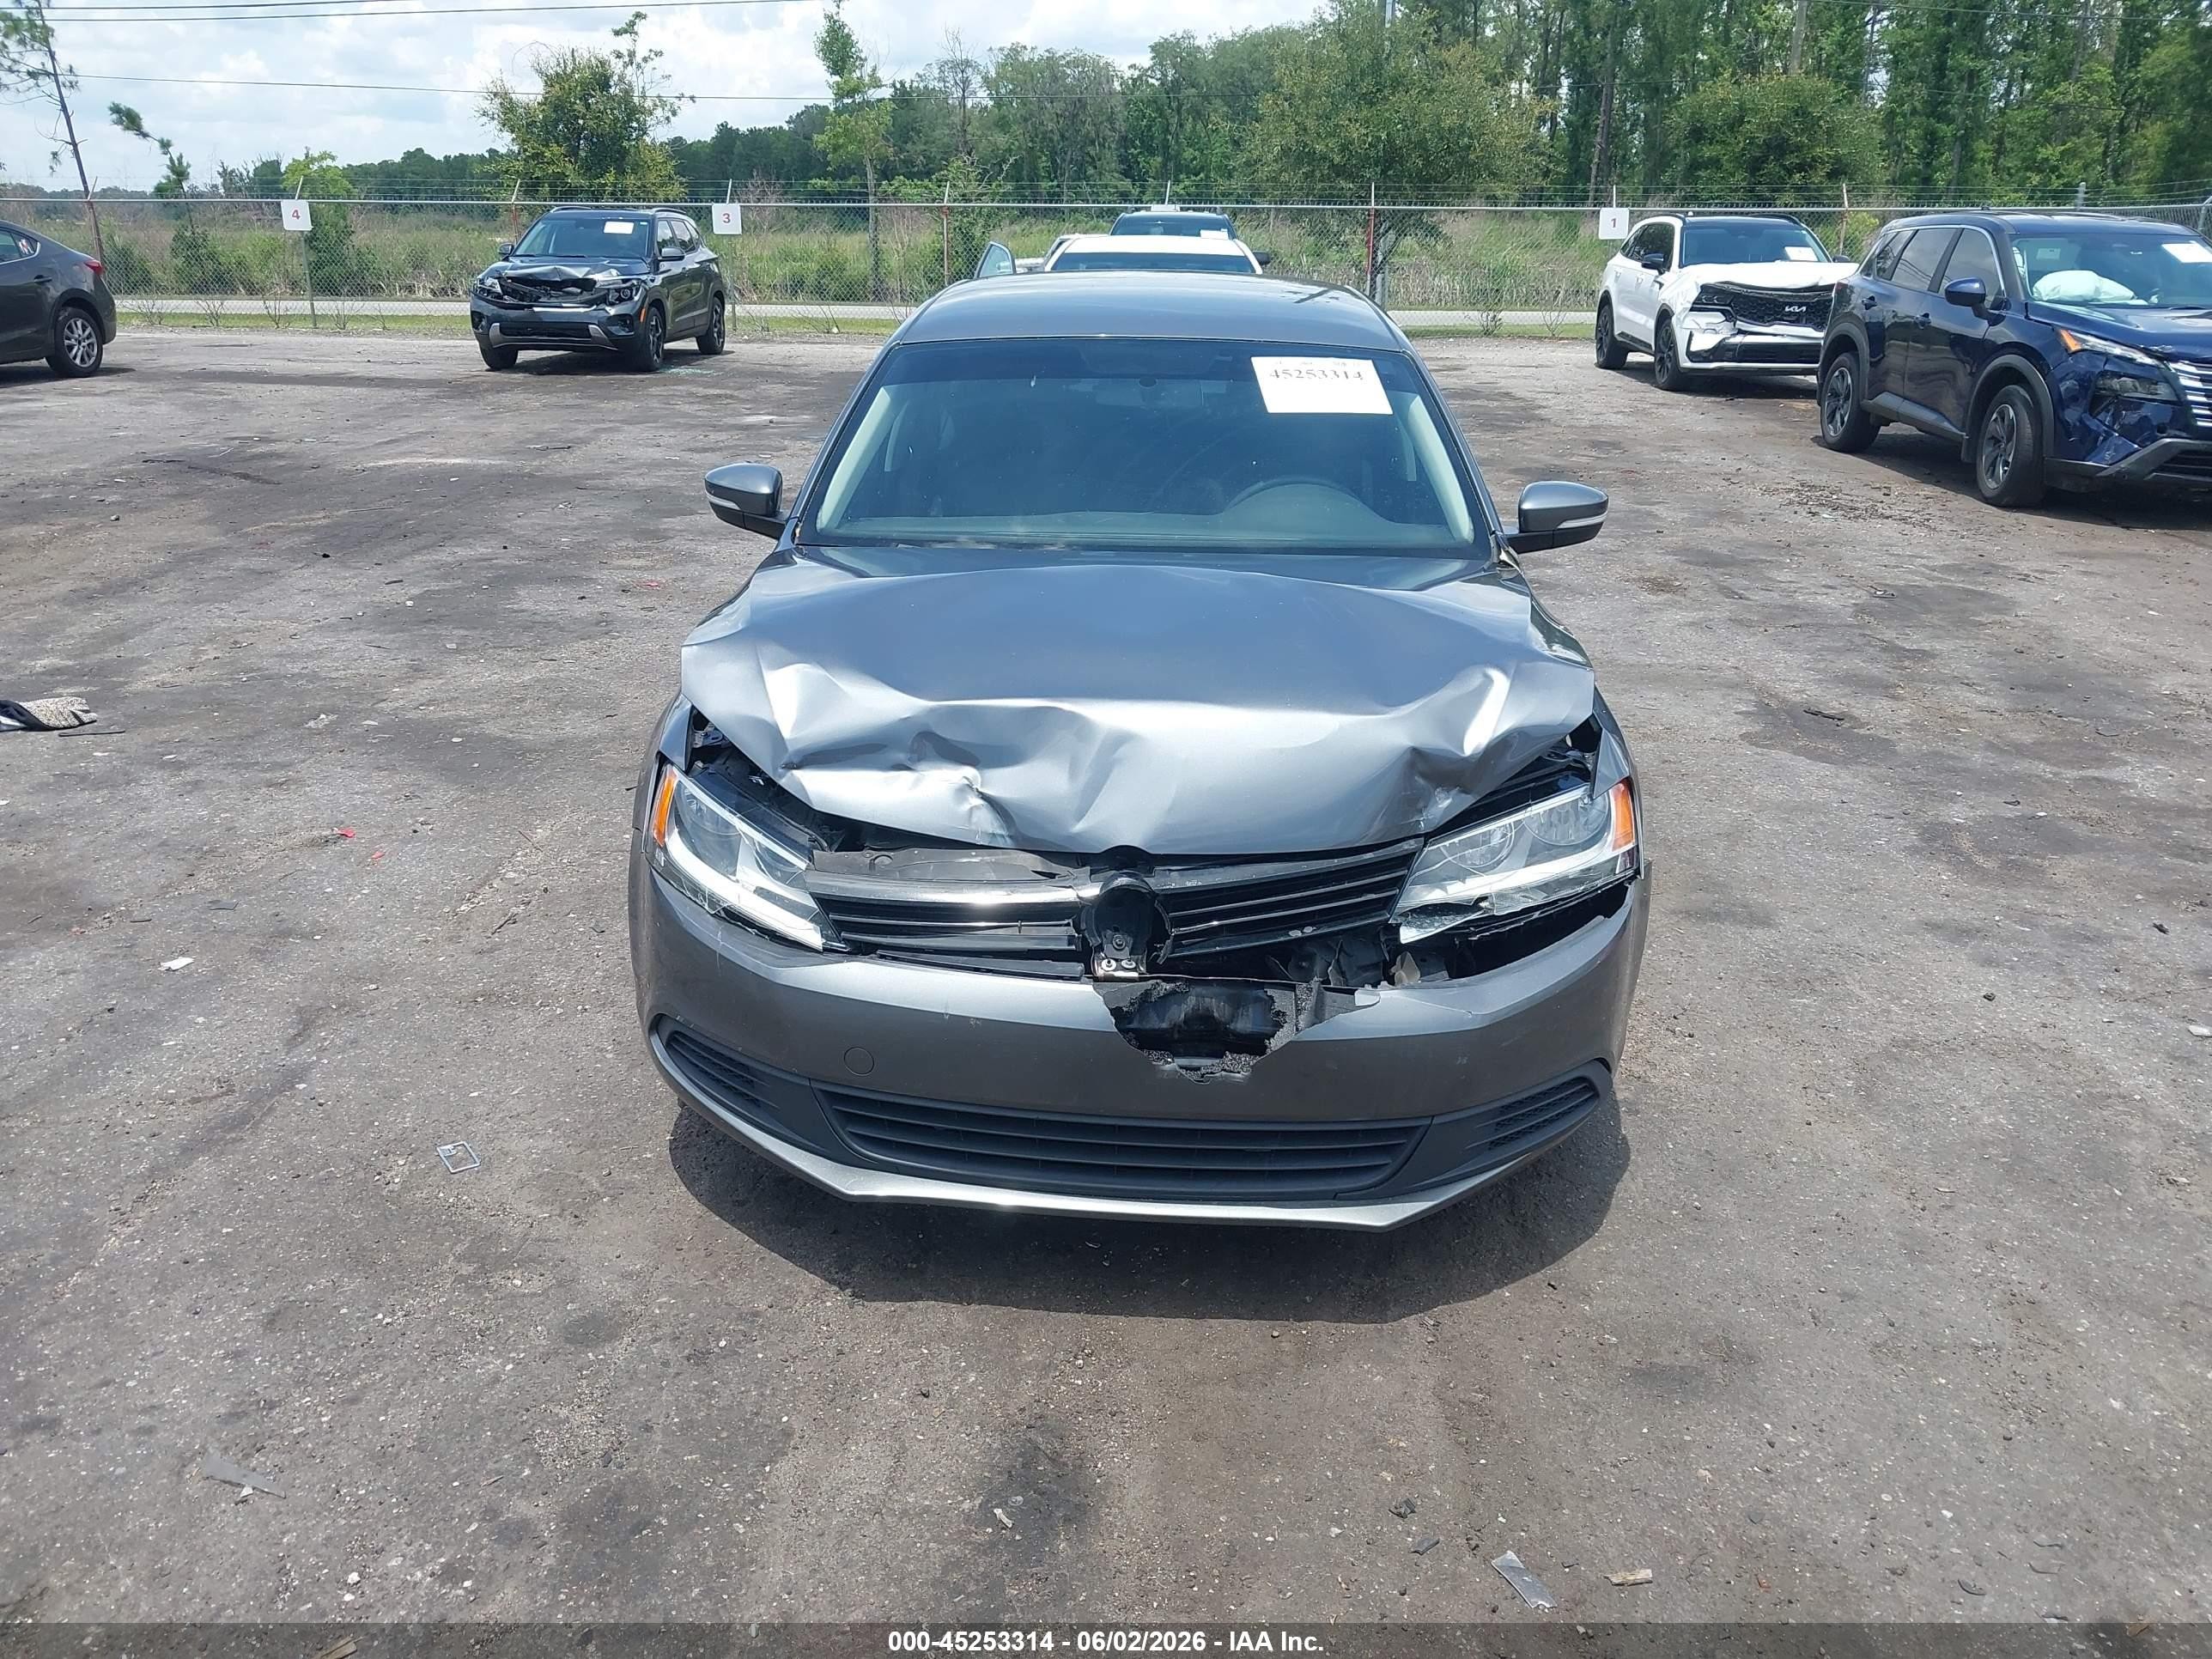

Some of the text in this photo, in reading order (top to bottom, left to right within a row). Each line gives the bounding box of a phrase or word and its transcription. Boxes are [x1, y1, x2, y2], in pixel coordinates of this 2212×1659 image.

[292, 210, 301, 220] 4
[722, 213, 731, 223] 3
[1610, 217, 1617, 228] 1
[1270, 368, 1364, 380] 45253314
